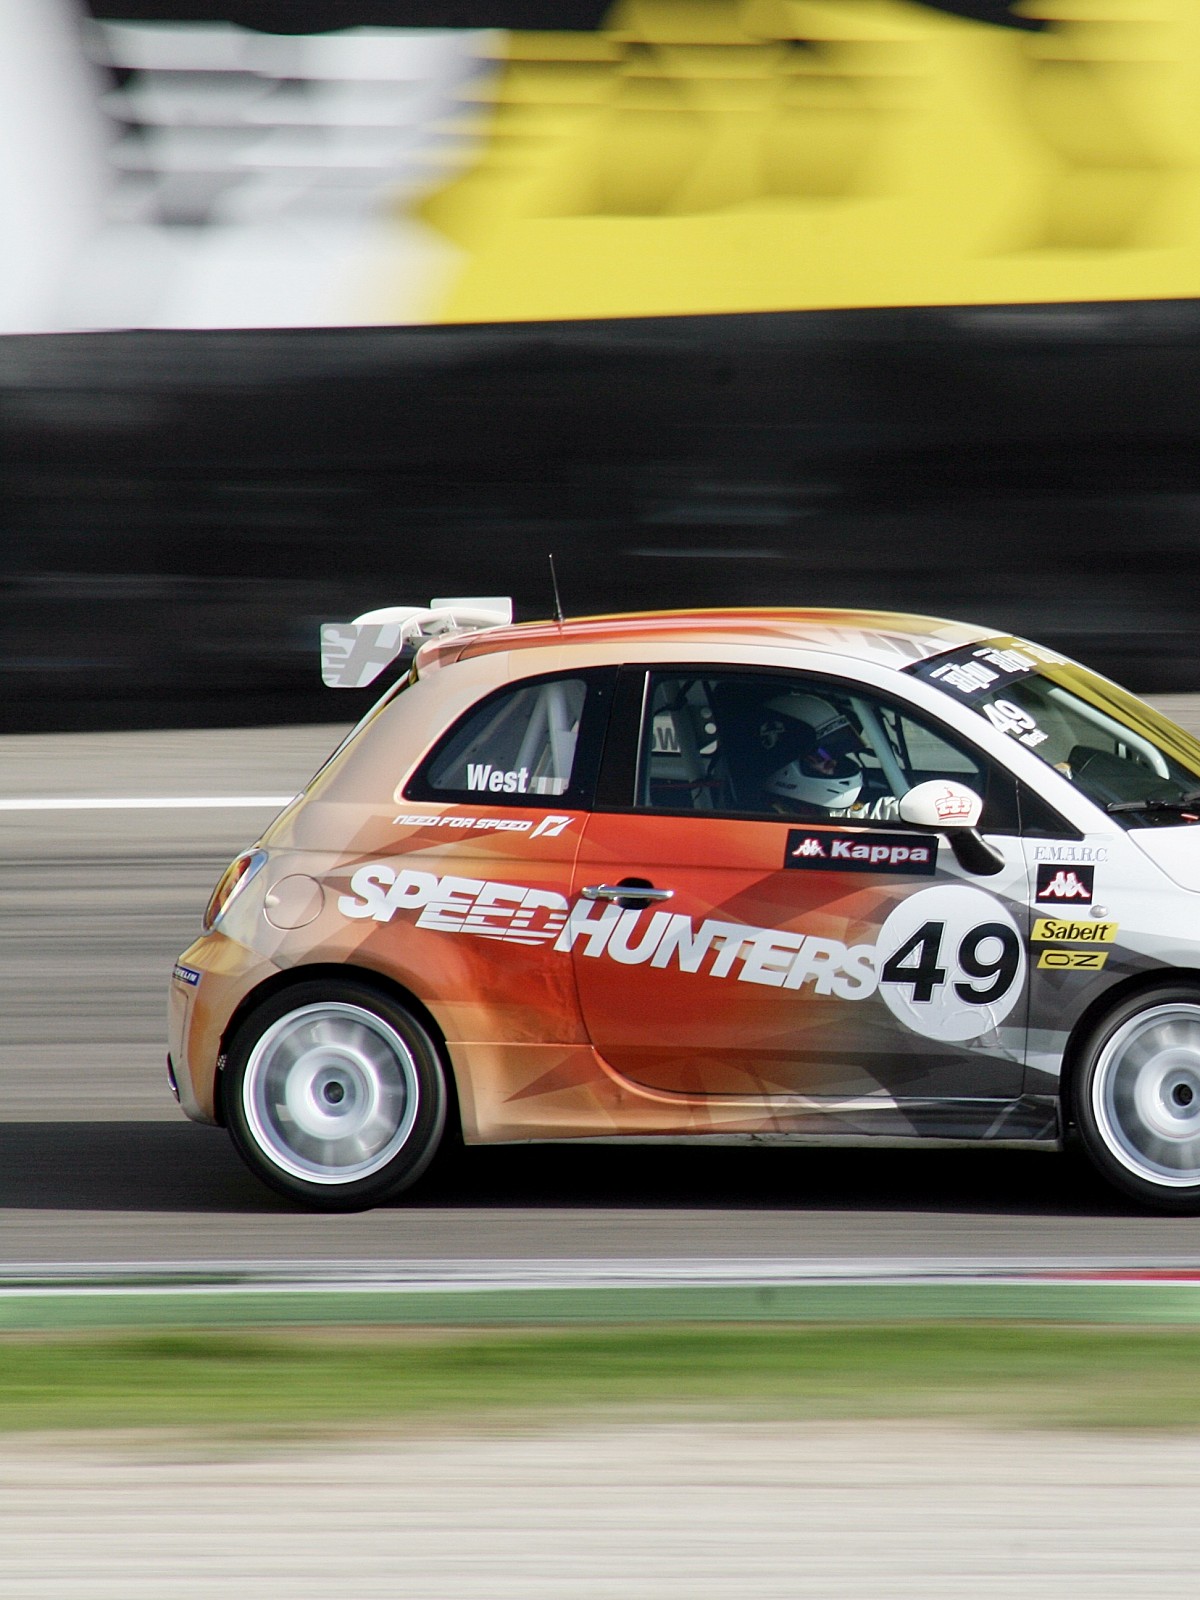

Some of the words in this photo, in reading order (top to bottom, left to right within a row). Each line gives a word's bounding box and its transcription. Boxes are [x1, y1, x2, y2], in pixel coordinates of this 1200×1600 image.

[982, 699, 1037, 734] 49
[467, 764, 529, 793] West
[393, 815, 441, 827] NEED
[438, 817, 474, 828] FOR
[473, 818, 533, 831] SPEED
[831, 841, 928, 863] Kappa
[338, 864, 877, 1001] SPEEDHUNTERS
[1041, 921, 1109, 941] Sabelt
[881, 921, 1020, 1005] 49
